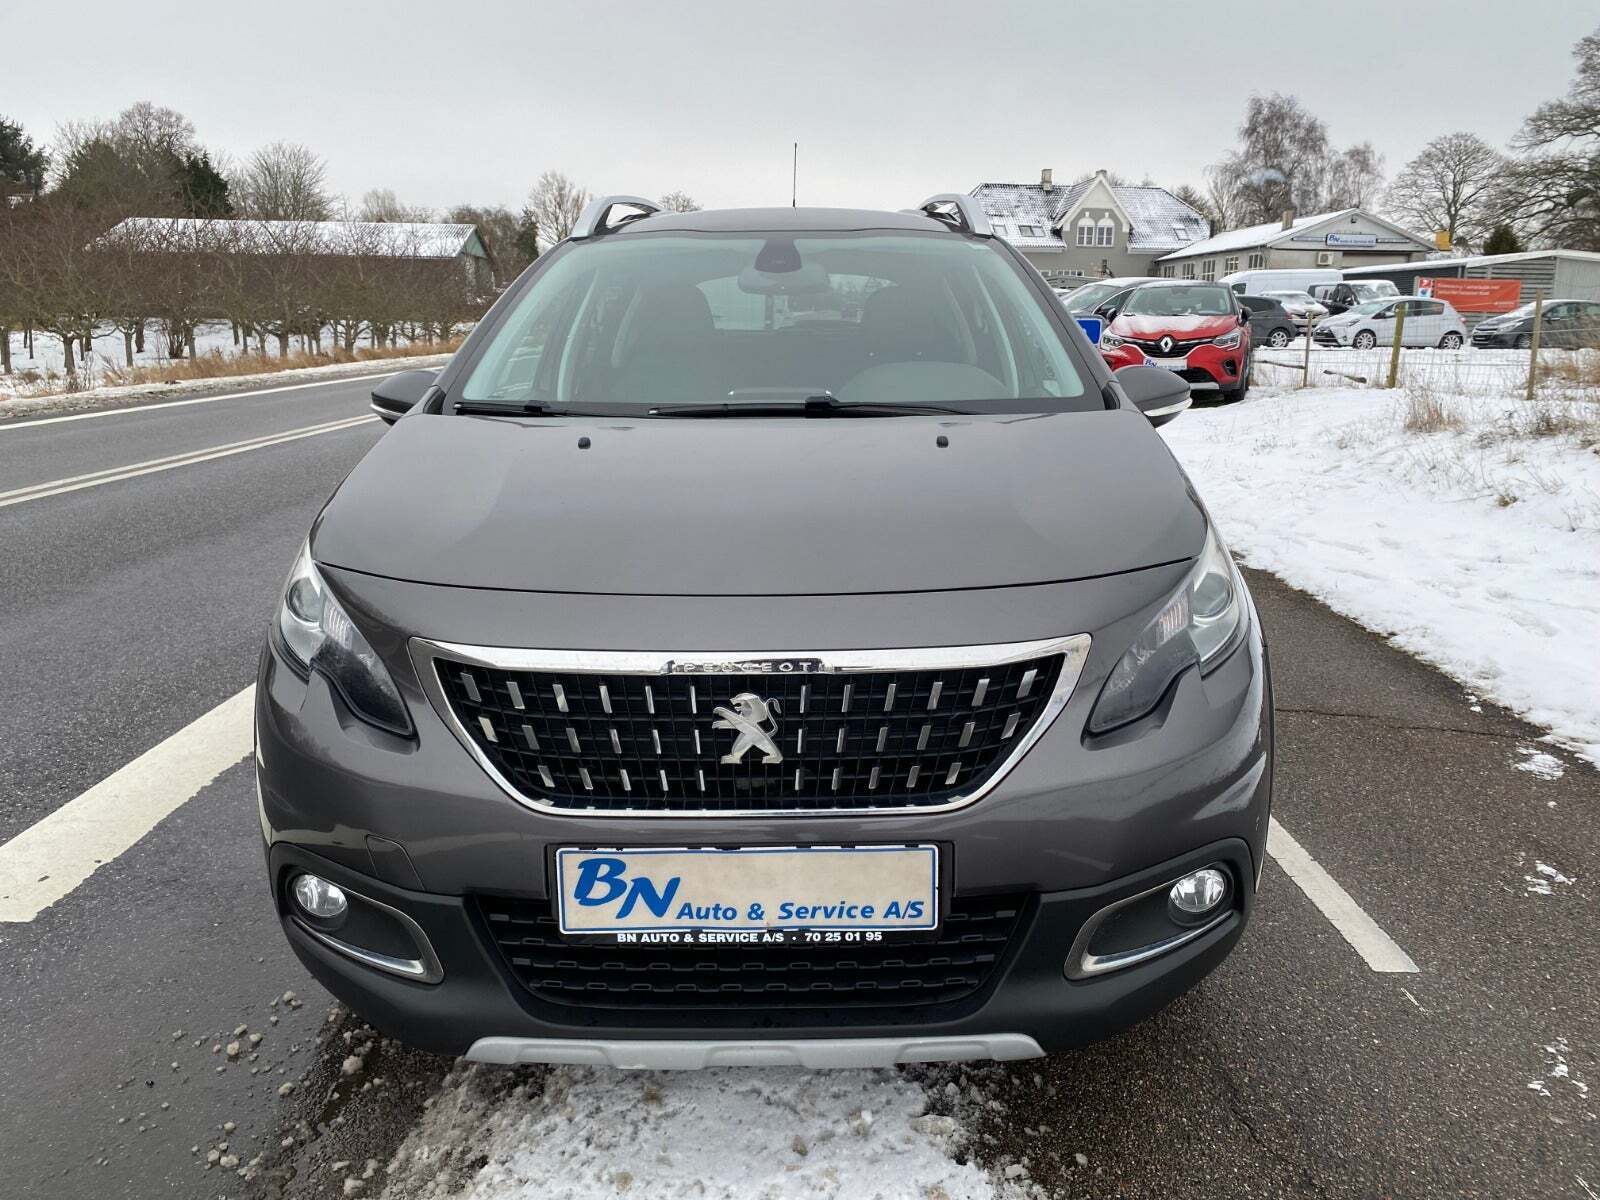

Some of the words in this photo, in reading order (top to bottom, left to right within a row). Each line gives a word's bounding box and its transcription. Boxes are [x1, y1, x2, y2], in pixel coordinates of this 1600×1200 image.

[574, 858, 681, 919] BN
[676, 902, 738, 920] Auto
[747, 902, 765, 920] &
[777, 901, 875, 919] Service
[883, 901, 924, 919] A/S
[617, 933, 637, 943] BN
[640, 933, 680, 943] AUTO
[683, 933, 694, 943] &
[698, 932, 758, 943] SERVICE
[762, 932, 785, 942] A/S
[805, 932, 821, 941] 70
[825, 932, 842, 941] 25
[845, 932, 860, 941] 01
[866, 931, 883, 941] 95
